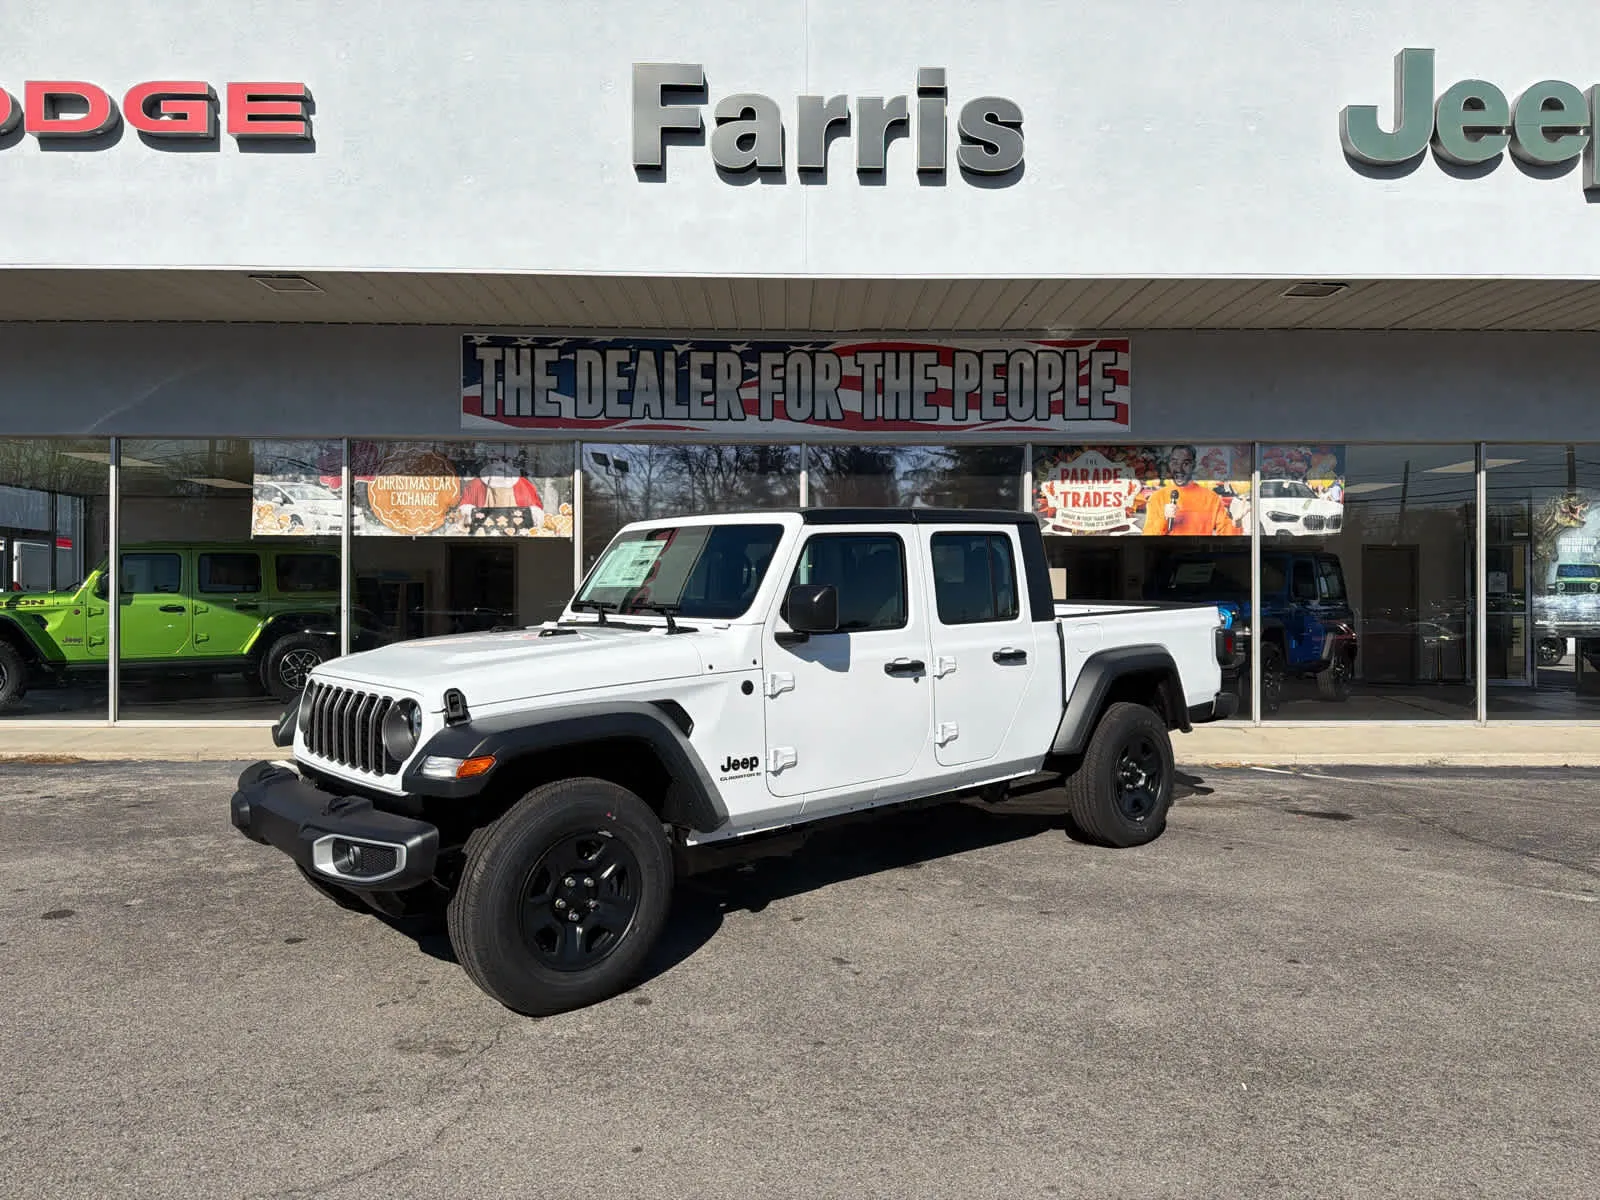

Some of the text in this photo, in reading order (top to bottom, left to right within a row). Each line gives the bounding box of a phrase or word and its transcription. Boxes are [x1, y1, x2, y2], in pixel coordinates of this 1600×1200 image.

[0, 80, 309, 136] DGE
[632, 63, 1024, 172] Farris
[1339, 48, 1600, 190] Jee
[476, 346, 1118, 421] THE DEALER FOR THE PEOPLE
[377, 476, 451, 491] CHRISTMAS CAR
[1060, 467, 1122, 484] PARADE
[391, 492, 438, 506] EXCHANGE
[1060, 491, 1122, 508] TRADES
[720, 755, 760, 773] Jeep
